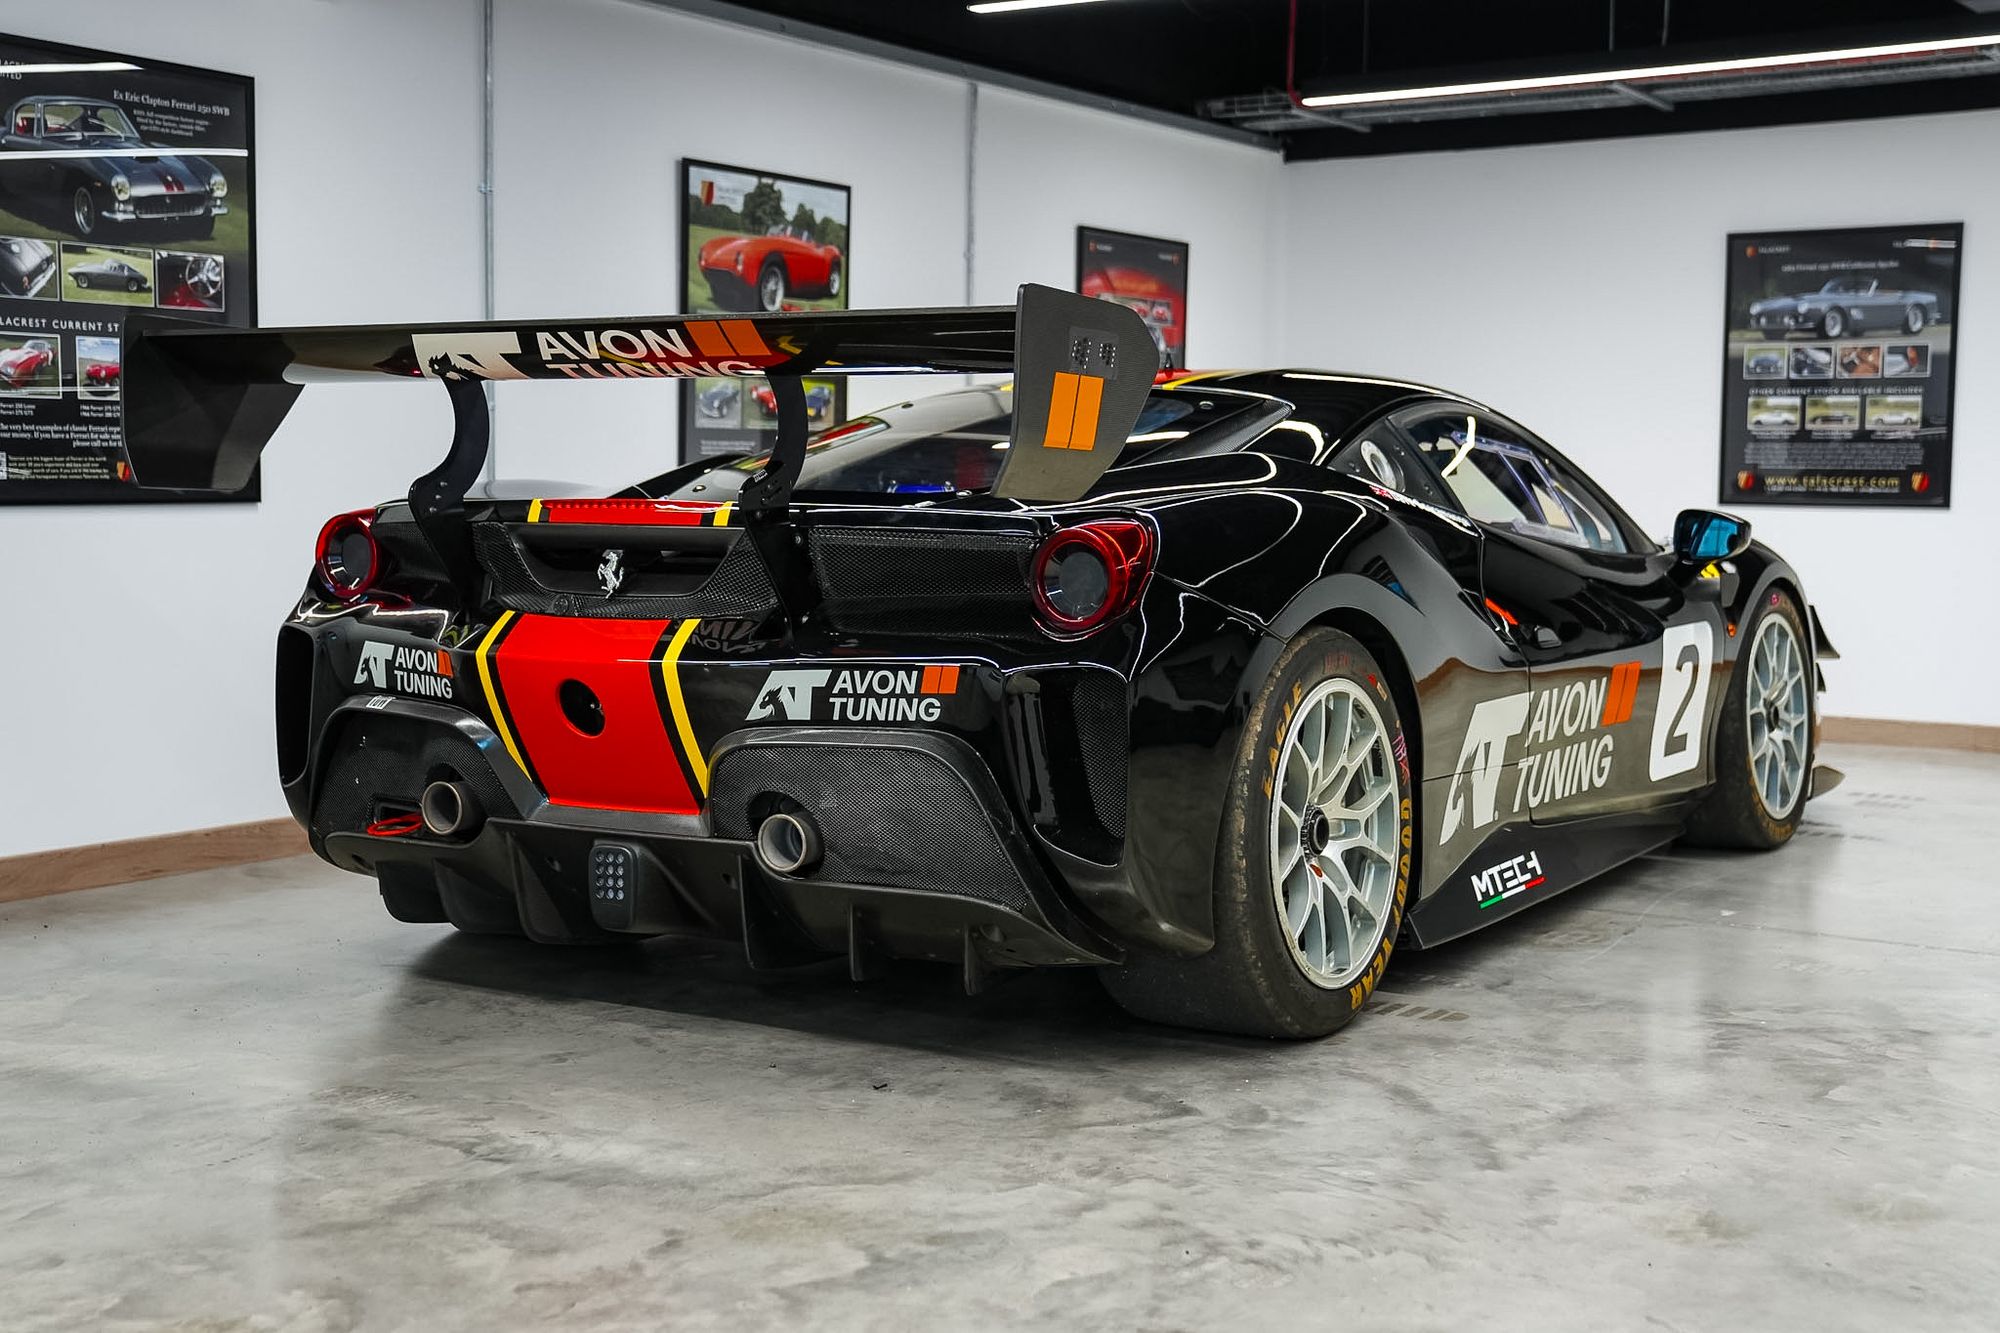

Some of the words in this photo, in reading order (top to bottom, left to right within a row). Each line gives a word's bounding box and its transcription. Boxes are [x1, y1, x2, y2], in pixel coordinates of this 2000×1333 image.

[124, 91, 140, 103] Eric
[141, 94, 170, 107] Clapton
[171, 99, 196, 112] Ferrari
[211, 105, 230, 116] SWB
[52, 319, 102, 331] CURRENT
[107, 322, 120, 332] ST
[535, 328, 694, 361] AVON
[395, 646, 438, 674] AVON
[393, 669, 453, 700] TUNING
[832, 670, 918, 695] AVON
[829, 697, 941, 722] TUNING
[1524, 676, 1608, 748] AVON
[1664, 644, 1700, 758] 2
[1262, 678, 1303, 801] EAGLE
[1512, 734, 1614, 814] TUNING
